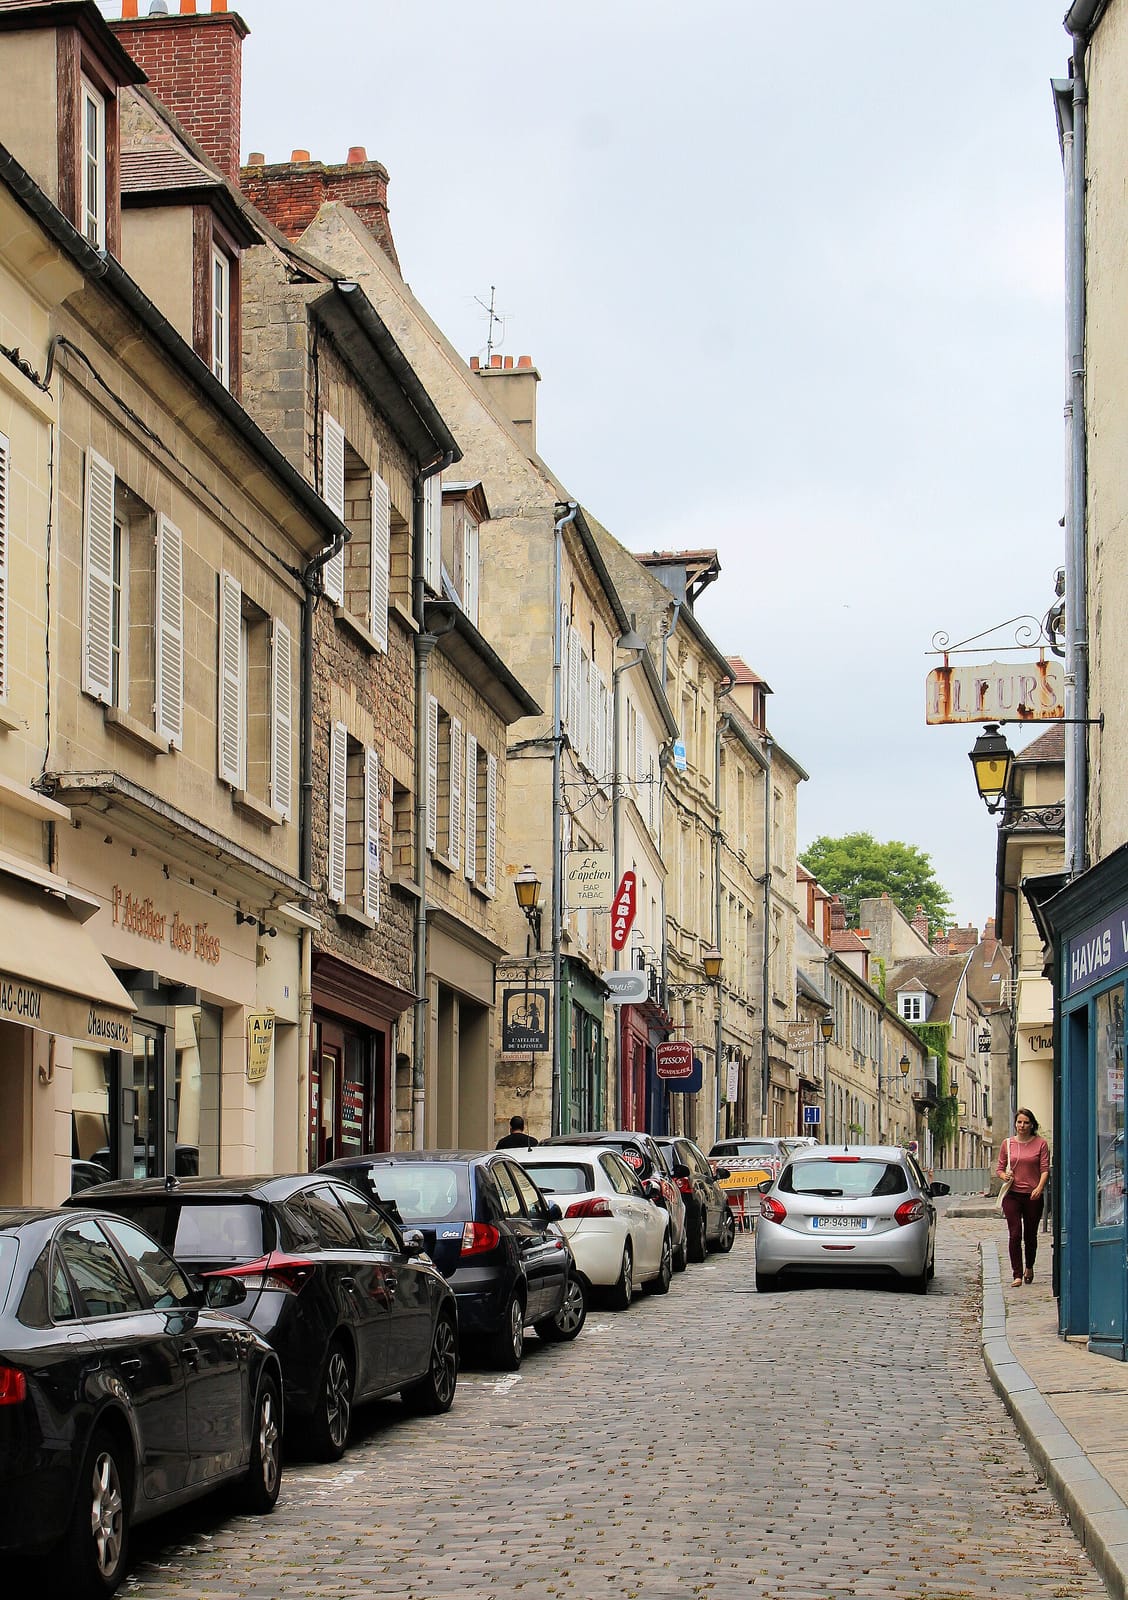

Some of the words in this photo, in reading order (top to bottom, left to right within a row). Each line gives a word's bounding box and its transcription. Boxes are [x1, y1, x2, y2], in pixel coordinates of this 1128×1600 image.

[933, 675, 1057, 714] FLEURS
[580, 858, 597, 870] Le
[578, 891, 604, 899] TABAC
[614, 880, 633, 941] TABAC
[171, 911, 192, 952] des
[1071, 929, 1111, 983] HAVAS
[0, 979, 41, 1019] AC-CHOU
[87, 1009, 129, 1044] Chaussures
[659, 1054, 689, 1065] PISSON
